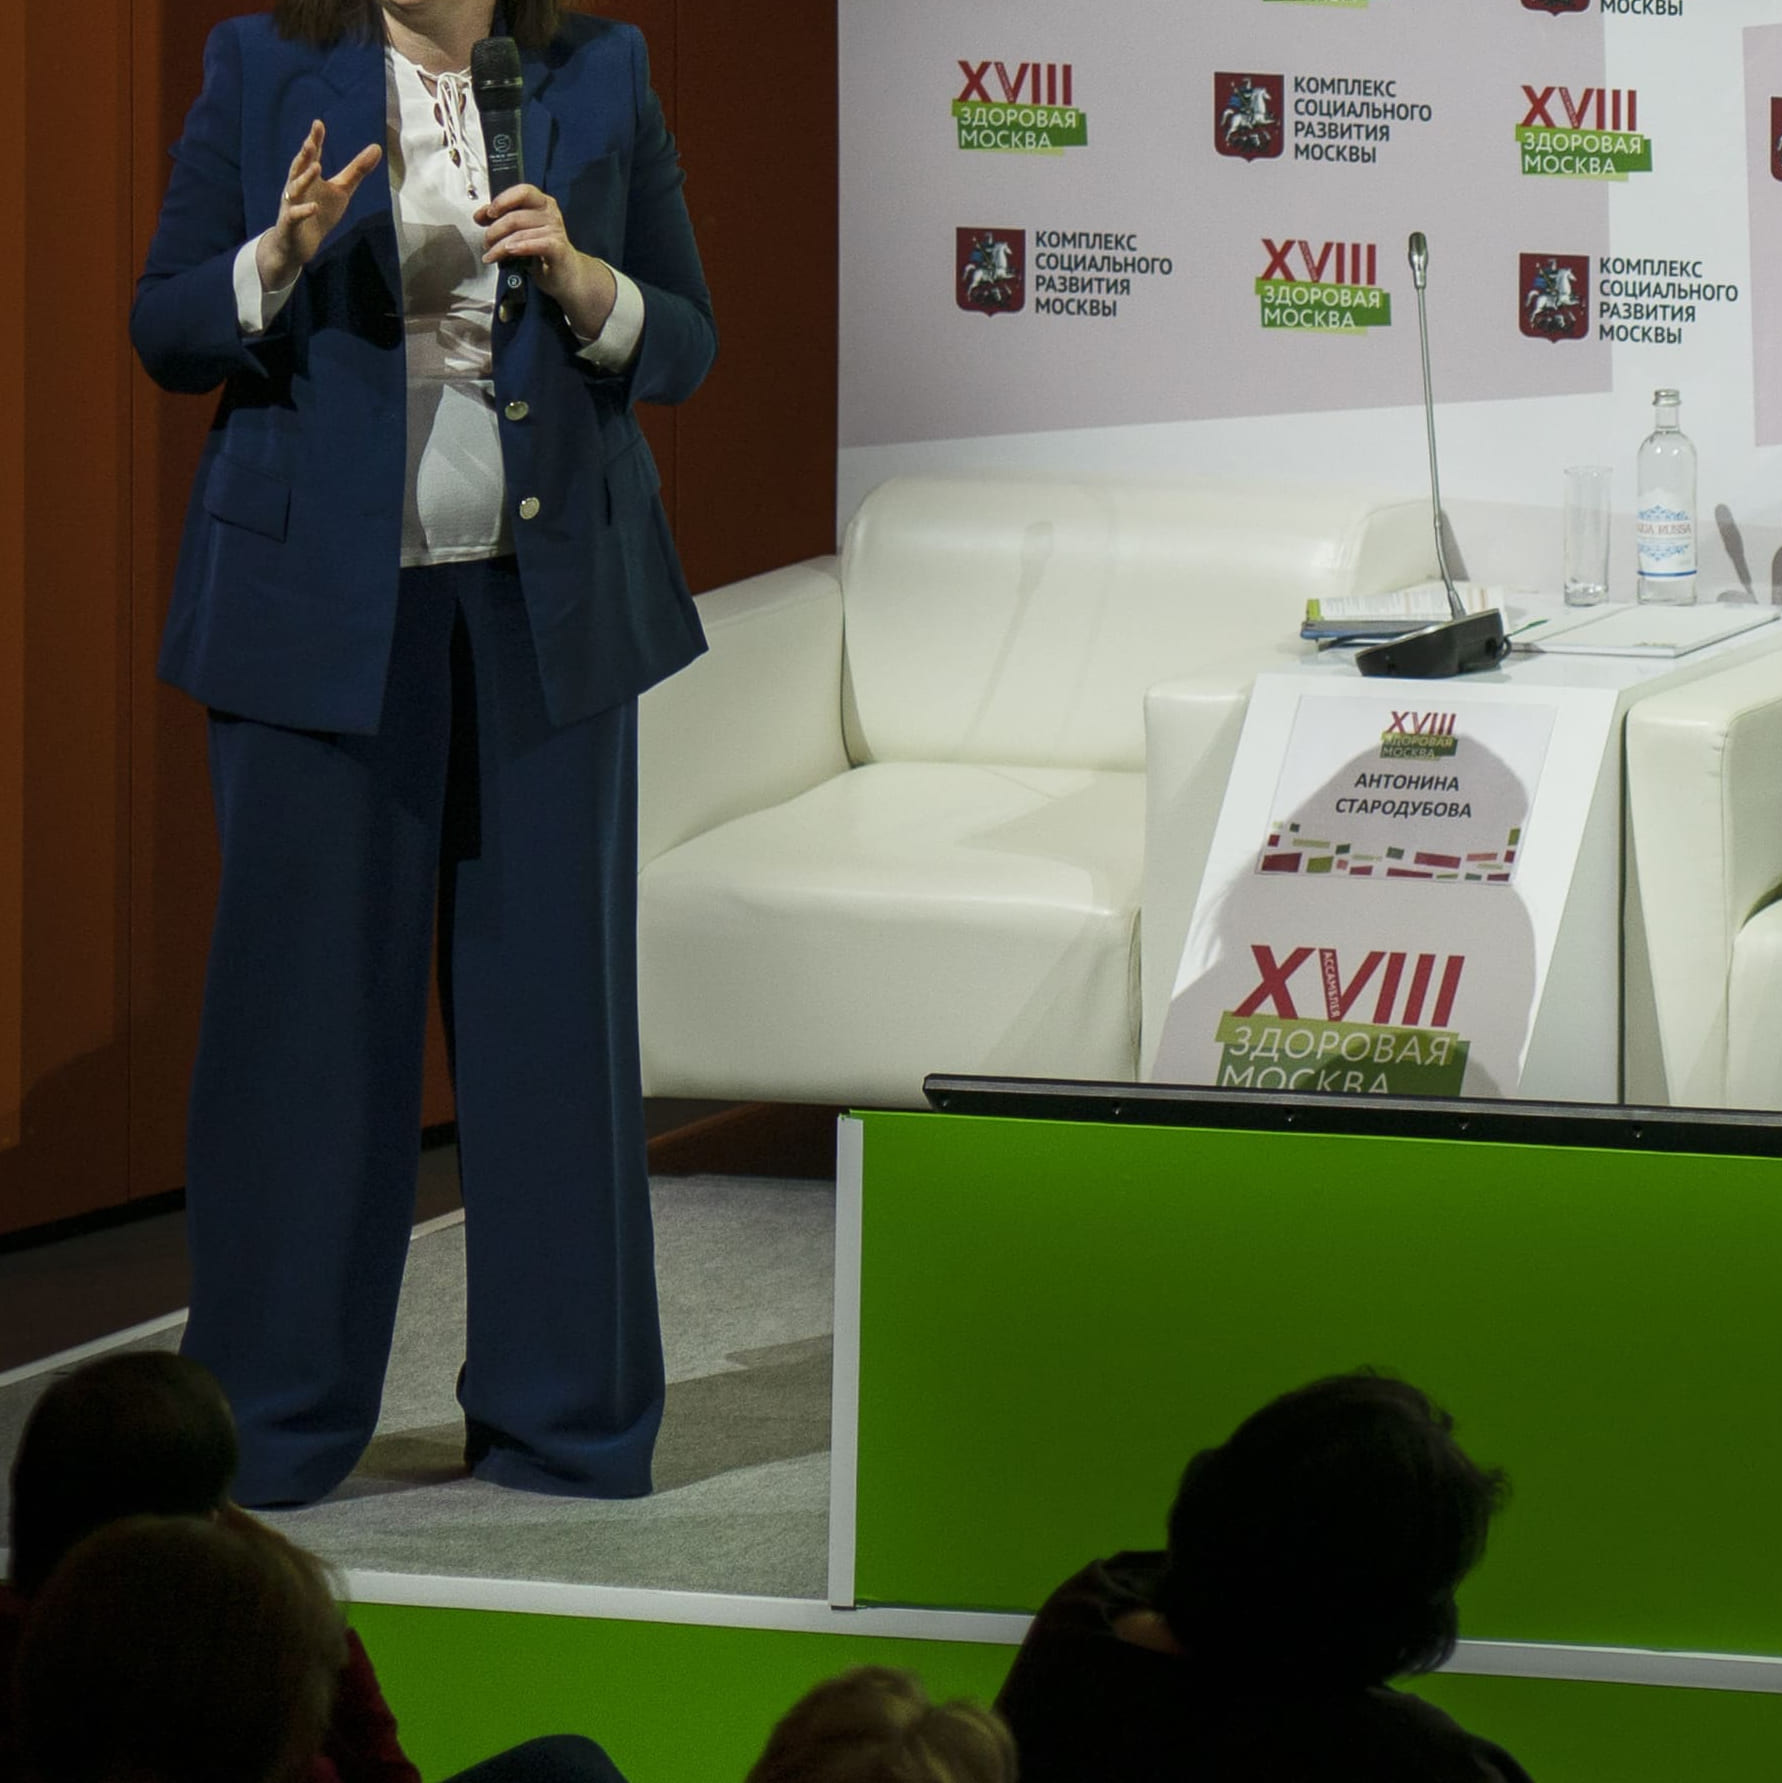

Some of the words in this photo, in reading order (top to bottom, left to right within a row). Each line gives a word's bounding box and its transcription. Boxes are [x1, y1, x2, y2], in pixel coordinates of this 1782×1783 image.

[958, 59, 1072, 106] XVIII
[959, 106, 1078, 126] ЗДОРОВАЯ
[960, 127, 1053, 146] МОСКВА
[1035, 230, 1138, 252] КОМПЛЕКС
[1034, 252, 1173, 276] СОЦИАЛЬНОГО
[1035, 274, 1131, 296] РАЗВИТИЯ
[1034, 296, 1117, 318] МОСКВЫ
[1386, 711, 1456, 735] XVIII
[1354, 772, 1459, 792] АНТОНИНА
[1335, 797, 1472, 819] СТАРОДУБОВА
[1232, 945, 1465, 1027] XVIII
[1229, 1026, 1450, 1067] ЗДОРОВАЯ
[1223, 1065, 1389, 1094] МОСКВА
